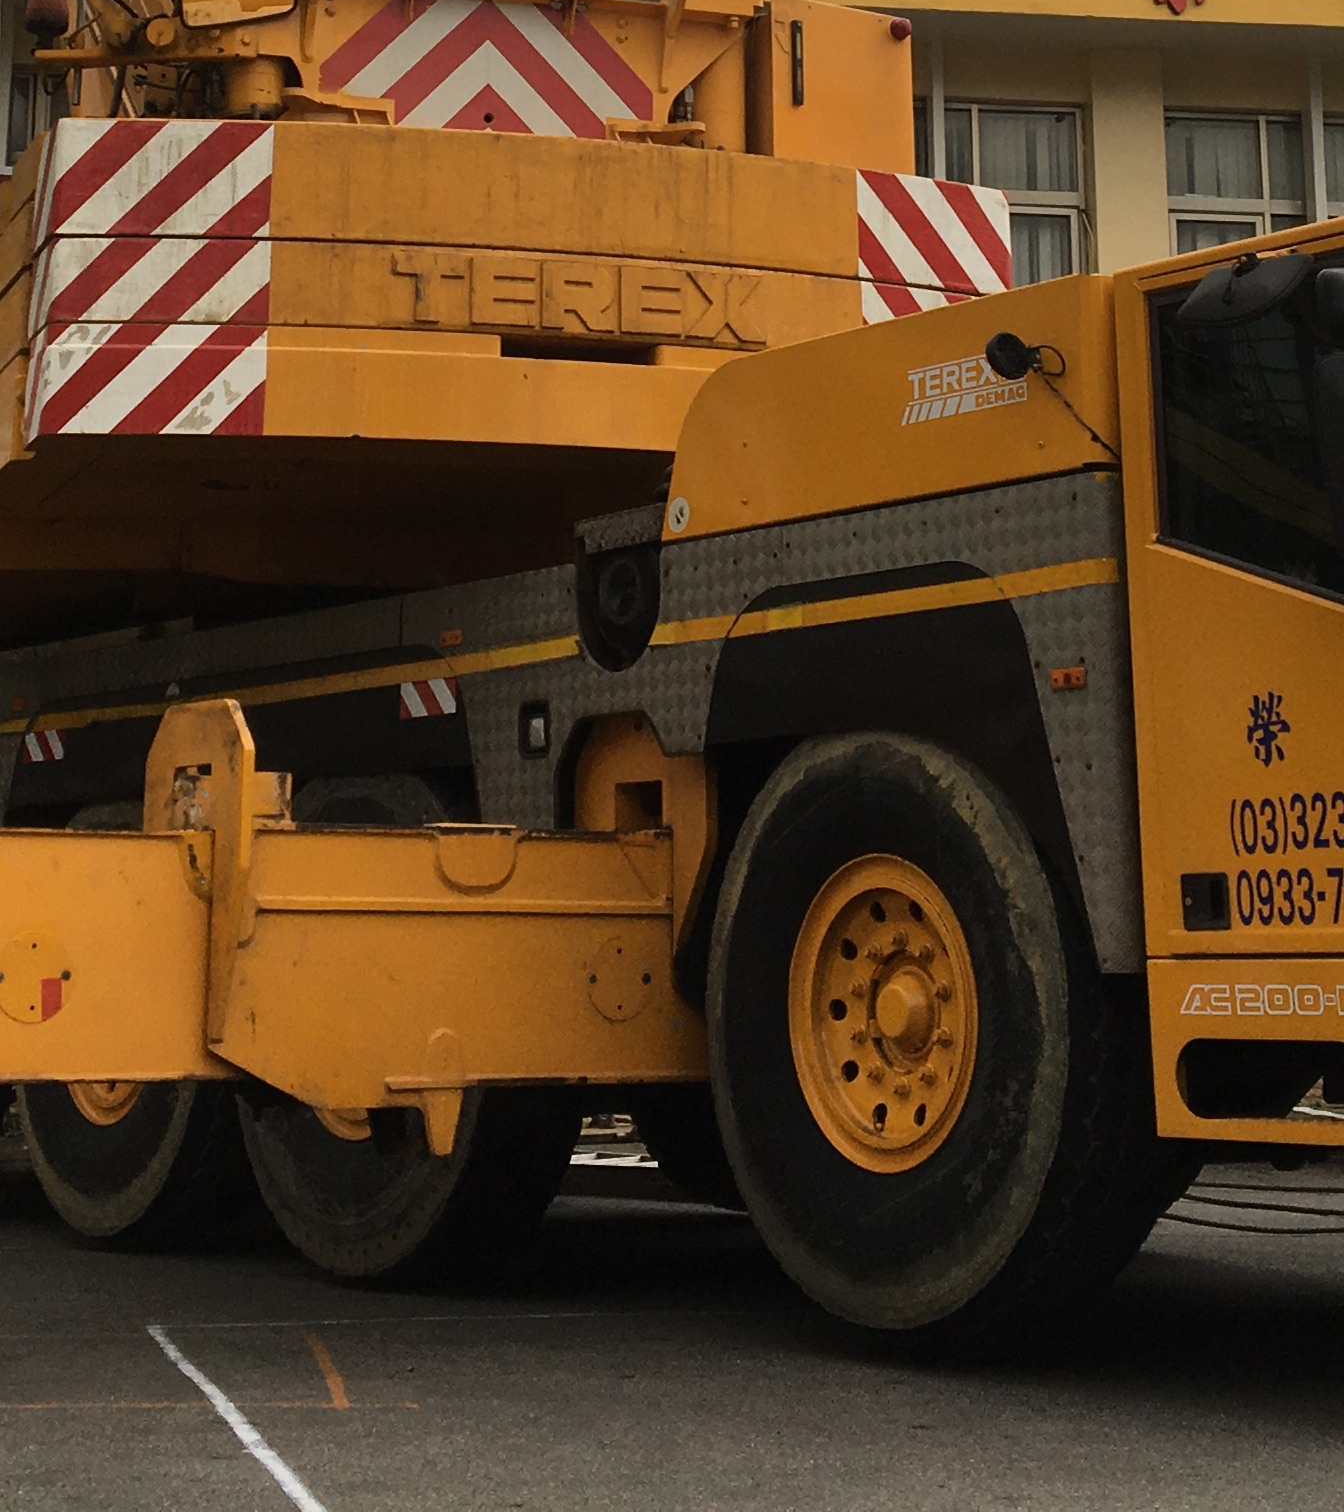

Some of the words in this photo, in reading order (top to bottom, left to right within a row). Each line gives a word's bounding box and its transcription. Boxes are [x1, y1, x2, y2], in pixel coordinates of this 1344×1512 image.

[390, 251, 768, 346] TEREX
[907, 357, 998, 400] TEREX
[974, 385, 1026, 408] DEMAG
